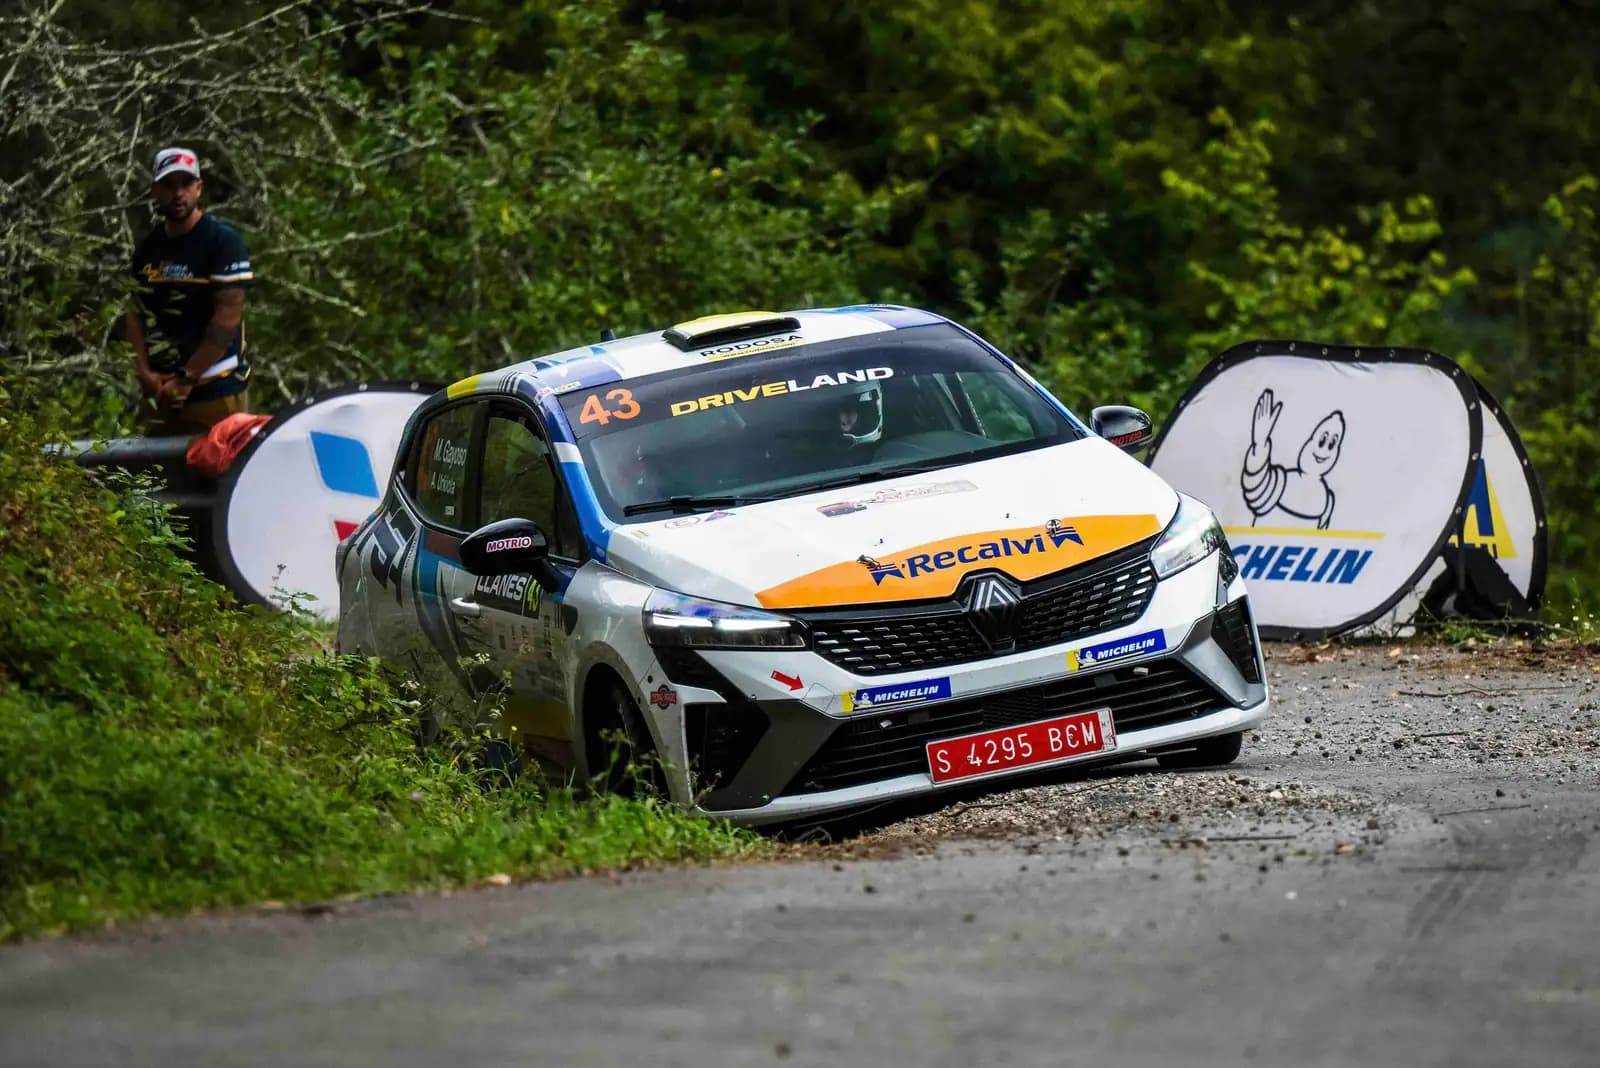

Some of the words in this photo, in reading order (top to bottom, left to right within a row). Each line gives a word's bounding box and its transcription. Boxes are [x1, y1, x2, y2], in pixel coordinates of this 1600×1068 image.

[700, 335, 803, 357] RODOSA
[579, 388, 641, 426] 43
[671, 366, 895, 417] DRIVELAND
[487, 537, 532, 552] MOTRIO
[906, 535, 1045, 578] Recalvi
[1232, 544, 1374, 584] CHELIN
[477, 575, 527, 601] LLANES
[1097, 637, 1155, 660] MICHELIN
[874, 685, 939, 703] MICHELIN
[936, 750, 951, 773] S
[969, 733, 1033, 767] 4295
[1048, 720, 1097, 753] BCM
